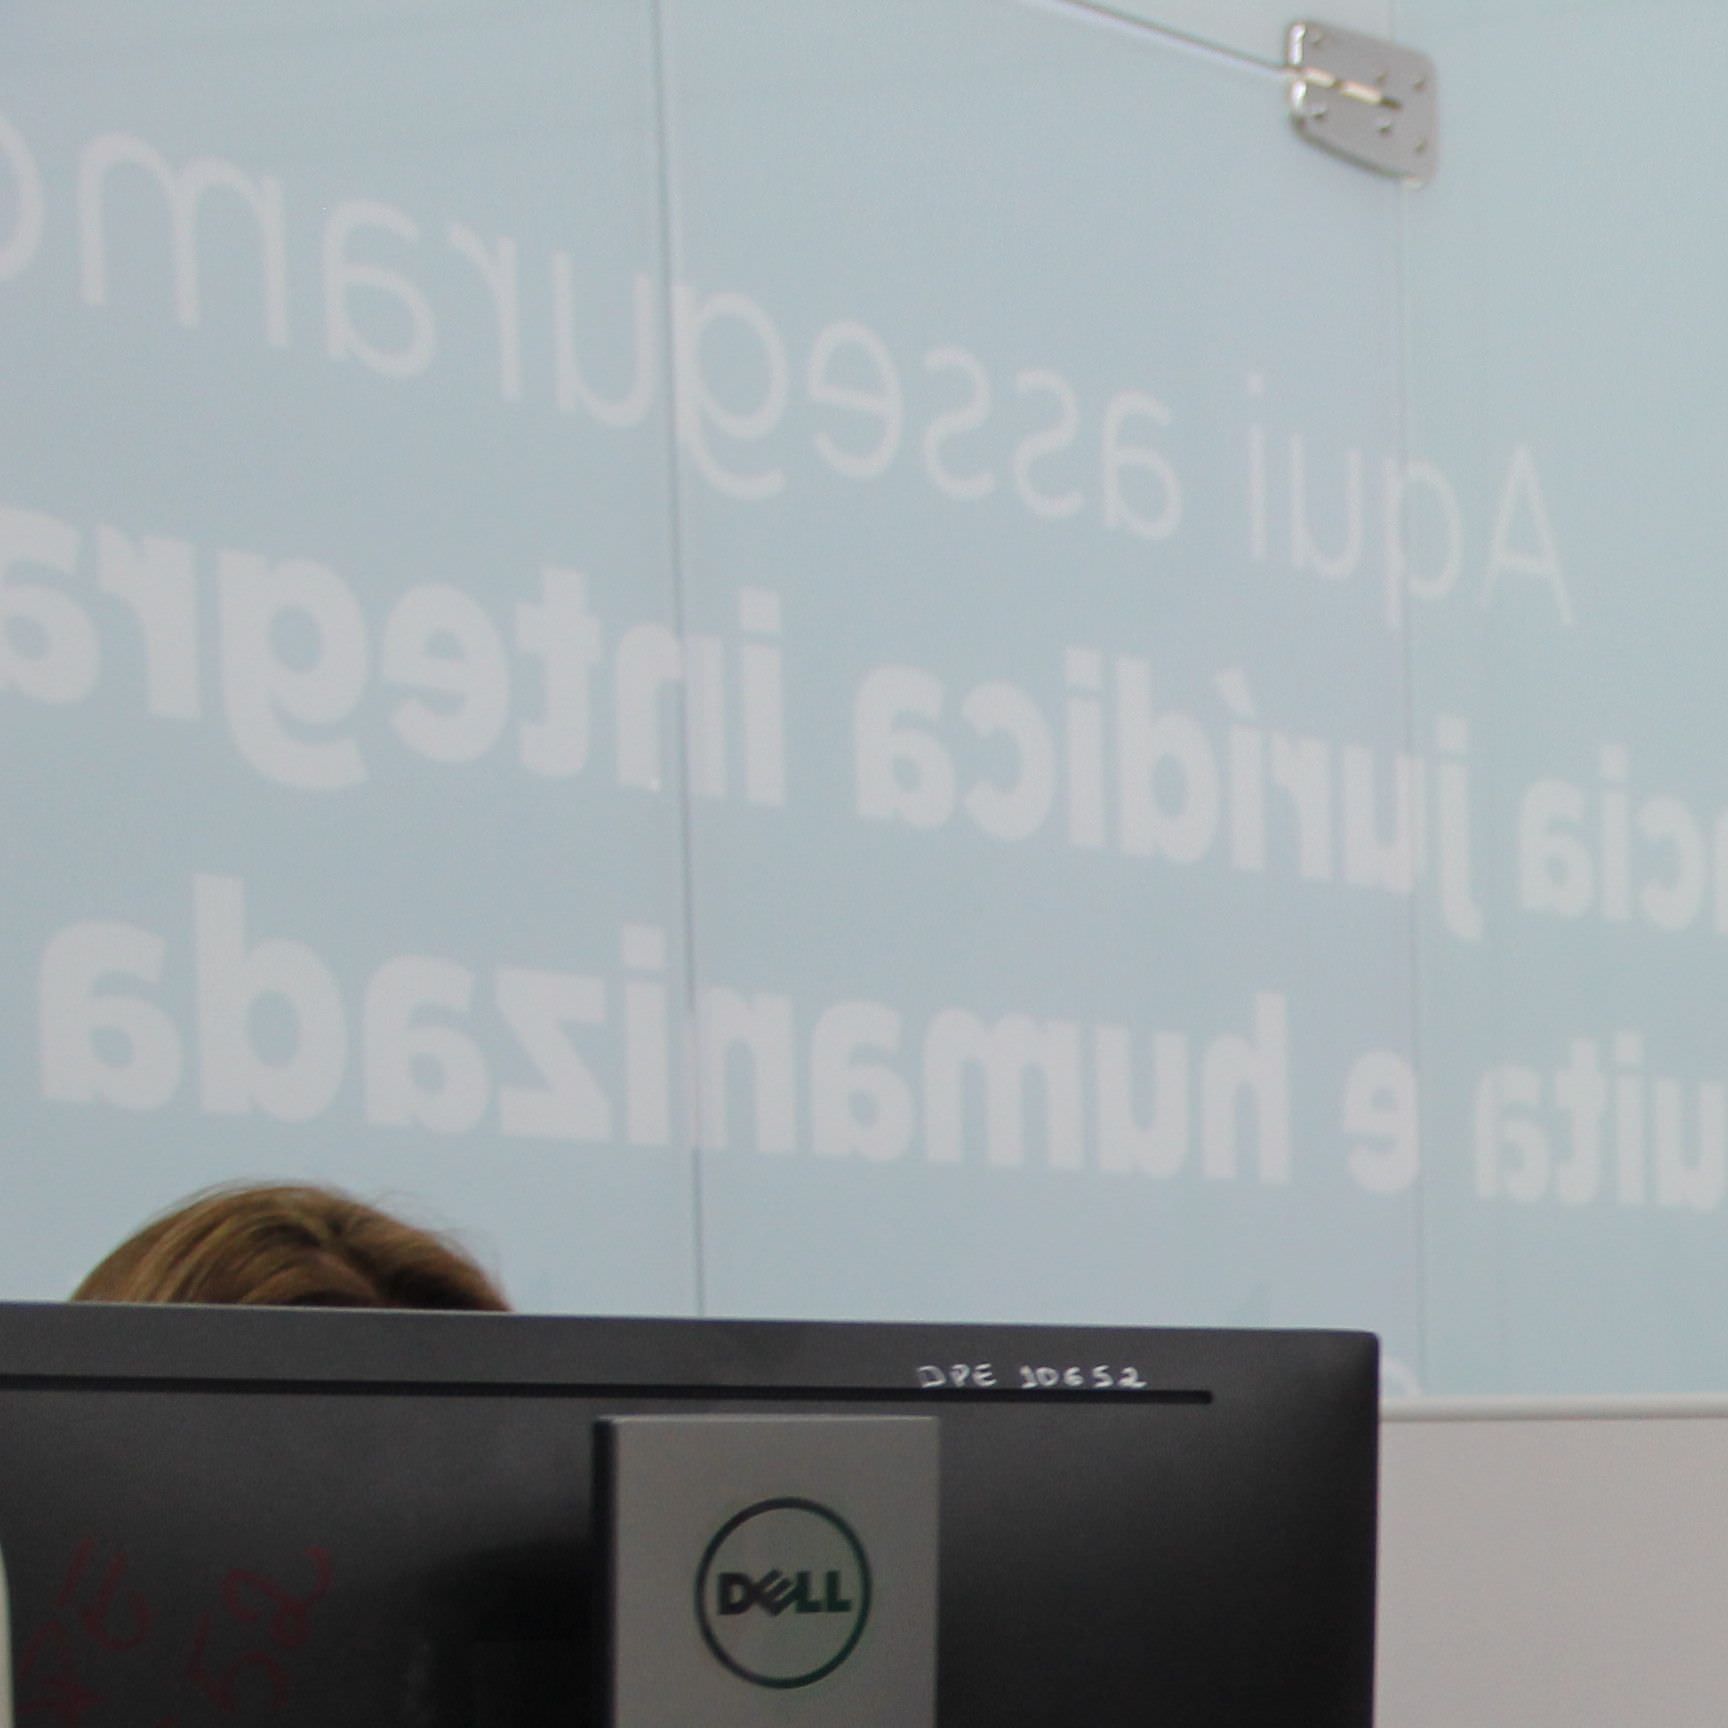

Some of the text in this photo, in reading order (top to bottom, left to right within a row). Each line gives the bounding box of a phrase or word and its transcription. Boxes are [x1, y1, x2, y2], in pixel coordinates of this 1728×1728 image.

[916, 1363, 1148, 1390] DPE 10652
[718, 1569, 852, 1618] DELL
